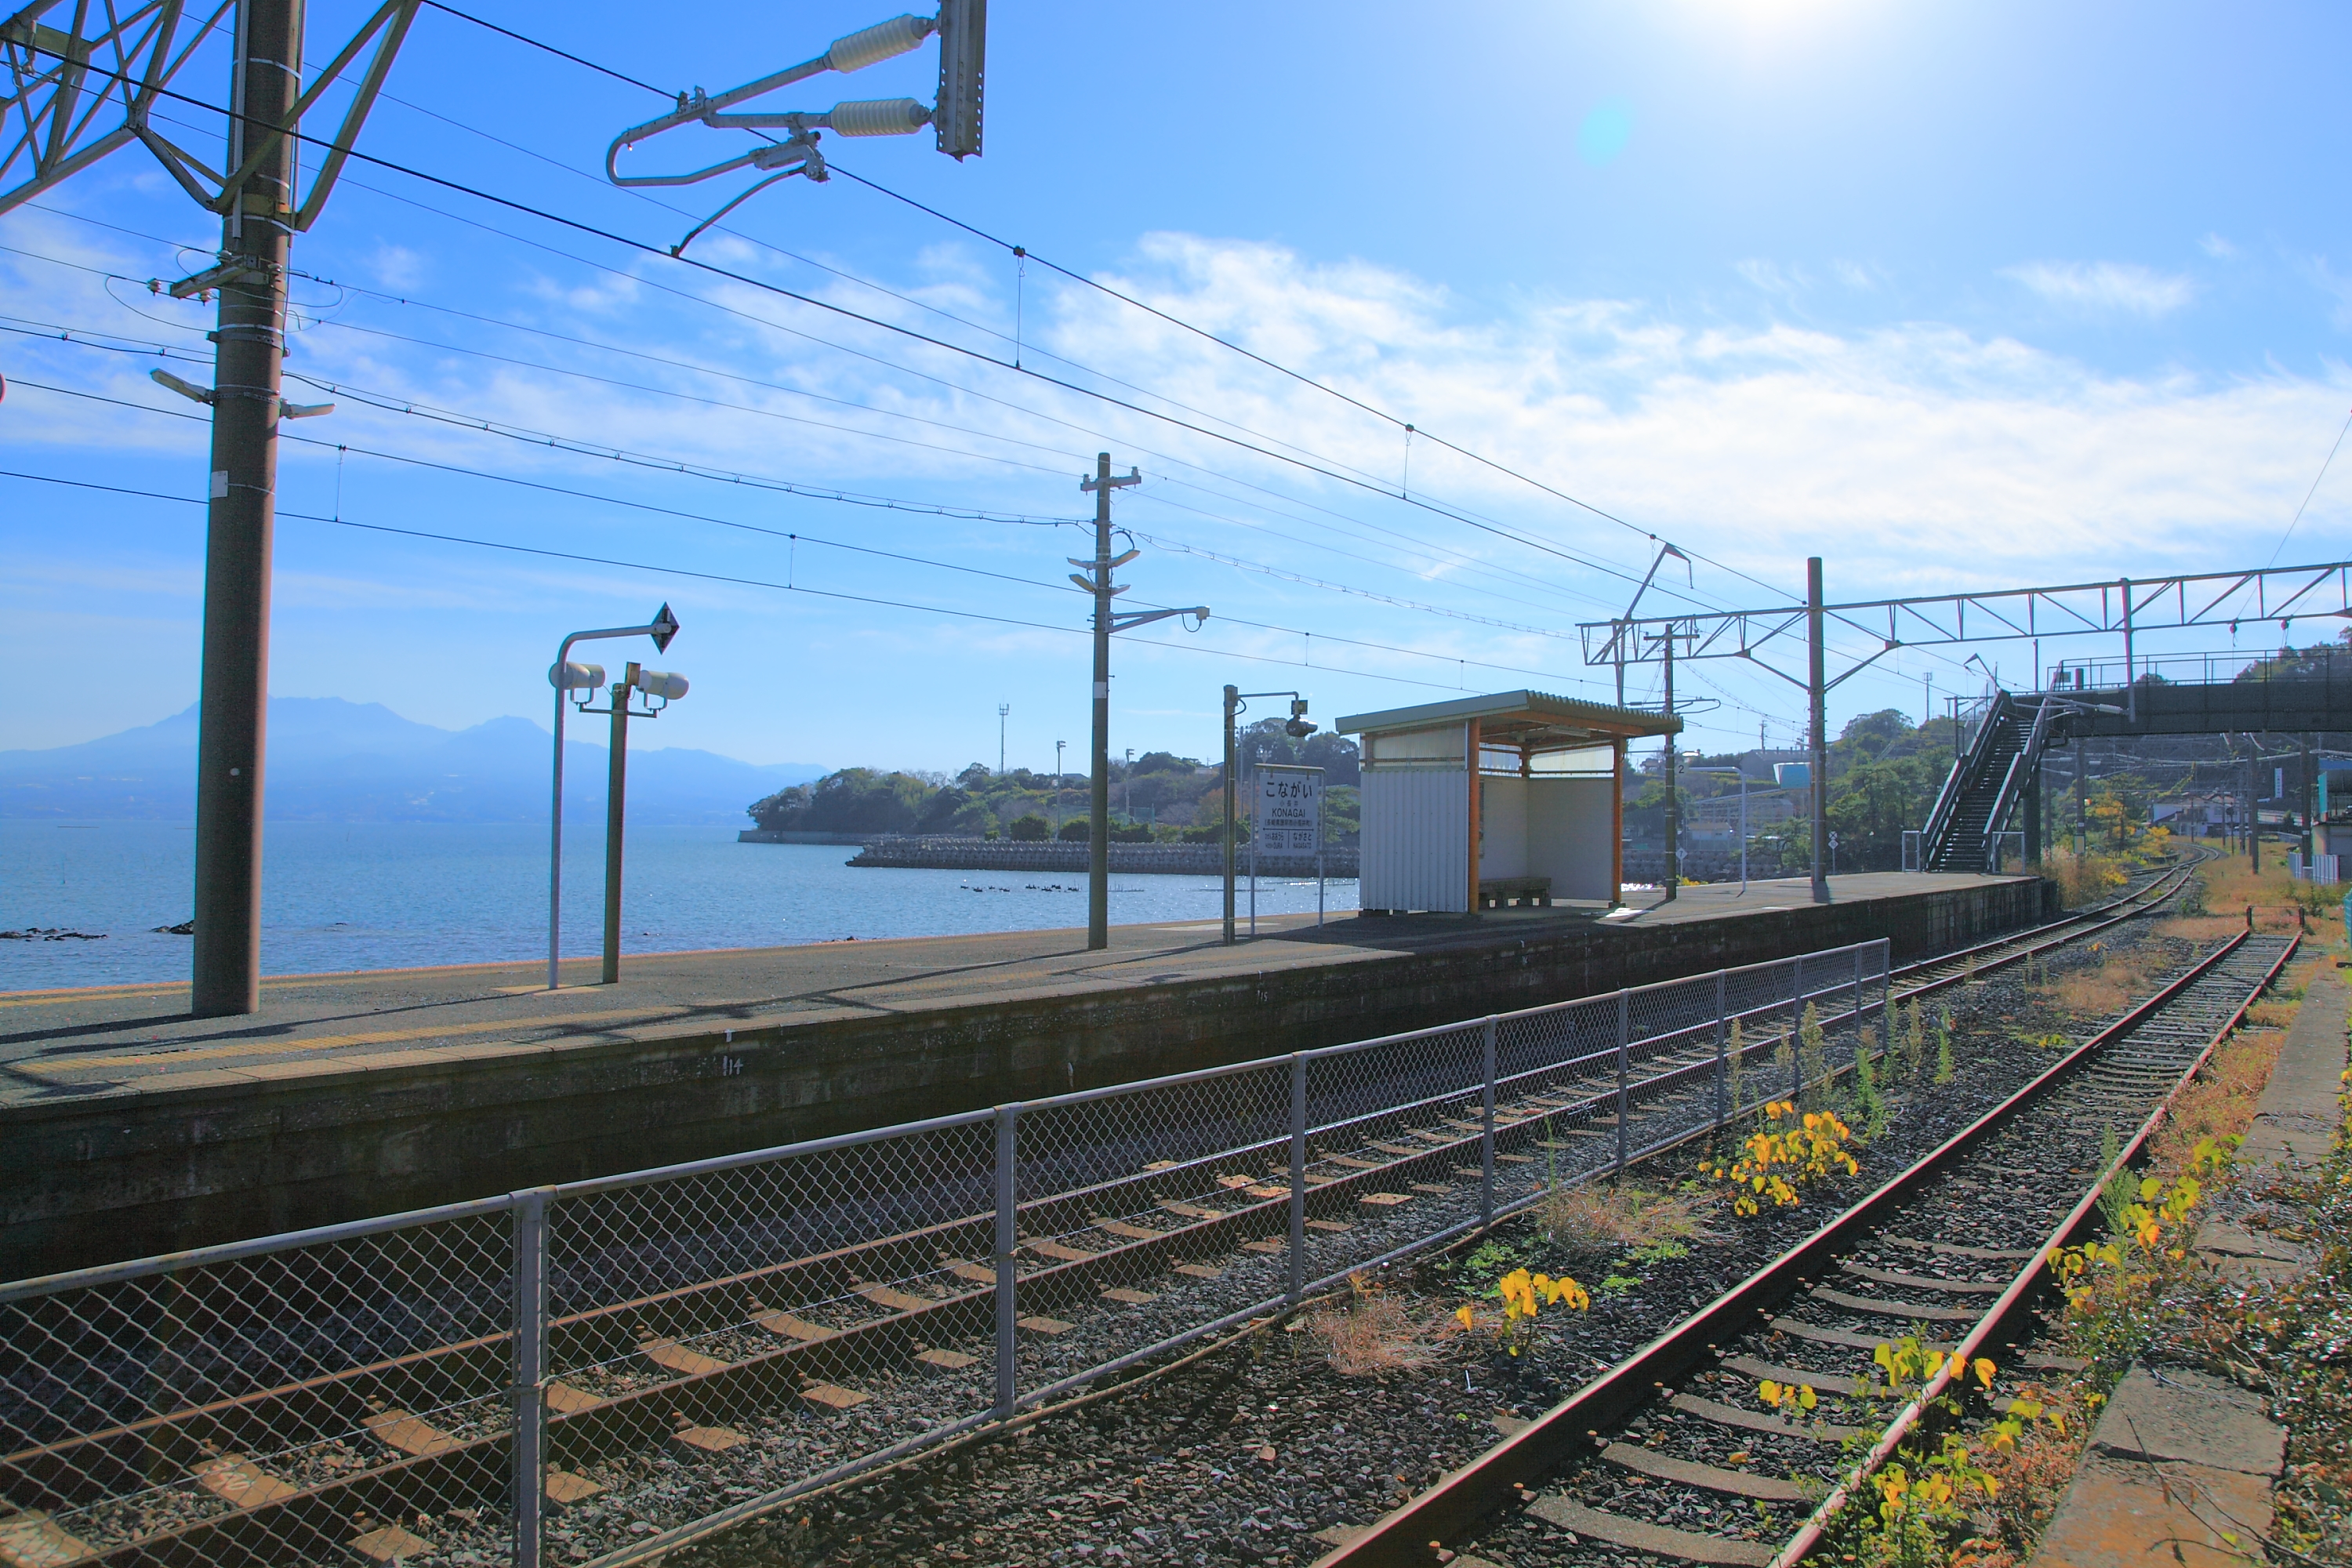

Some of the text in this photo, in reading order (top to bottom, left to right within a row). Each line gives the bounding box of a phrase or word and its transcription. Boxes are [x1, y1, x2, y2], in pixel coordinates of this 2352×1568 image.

[1679, 764, 1684, 773] 2
[1266, 782, 1312, 799] こながい
[1272, 808, 1306, 818] KONAGAI
[1293, 832, 1312, 842] ながさと
